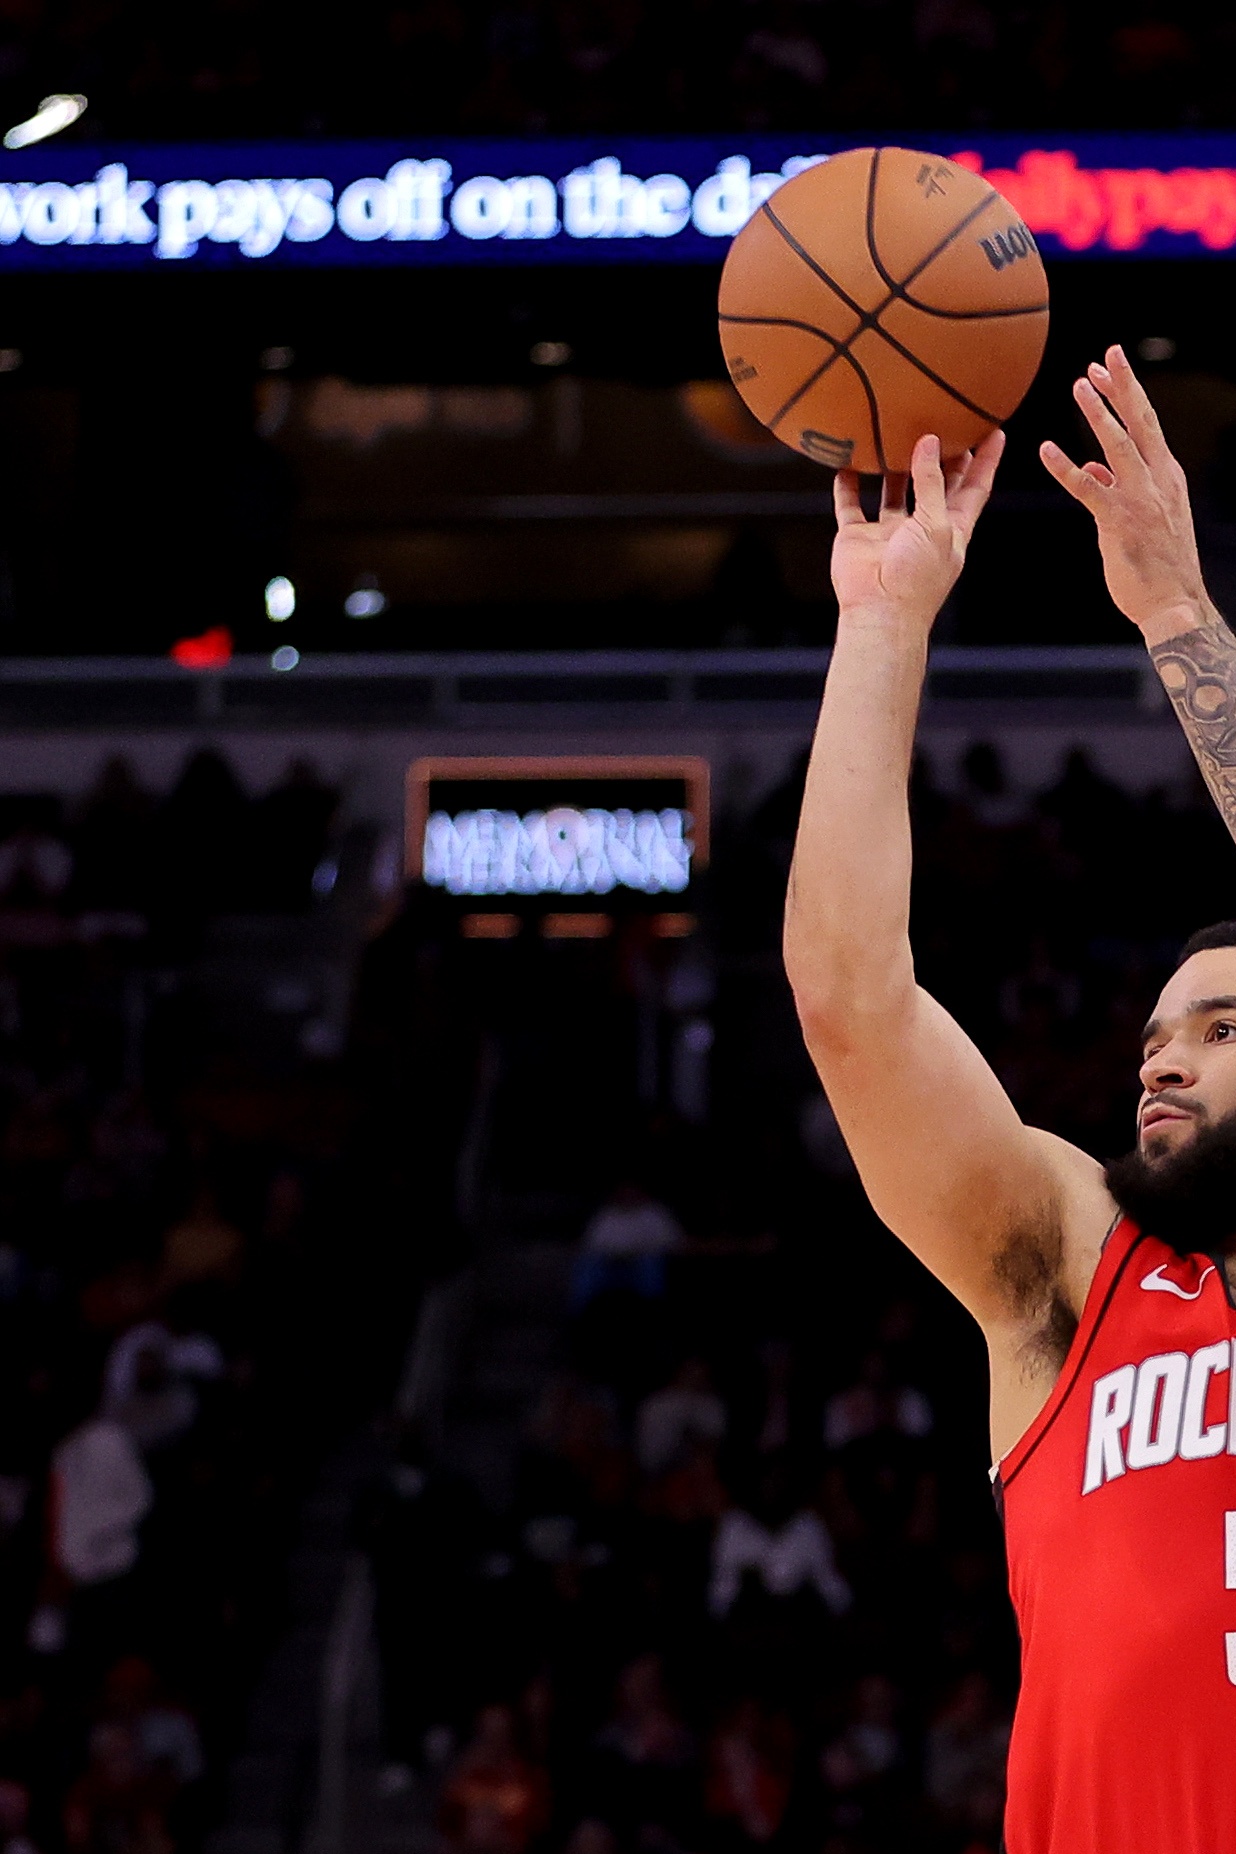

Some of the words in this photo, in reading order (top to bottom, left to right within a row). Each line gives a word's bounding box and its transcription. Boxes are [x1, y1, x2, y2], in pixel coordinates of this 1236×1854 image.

[152, 178, 334, 259] pays
[337, 158, 452, 241] off
[450, 175, 562, 240] on
[557, 156, 692, 238] the
